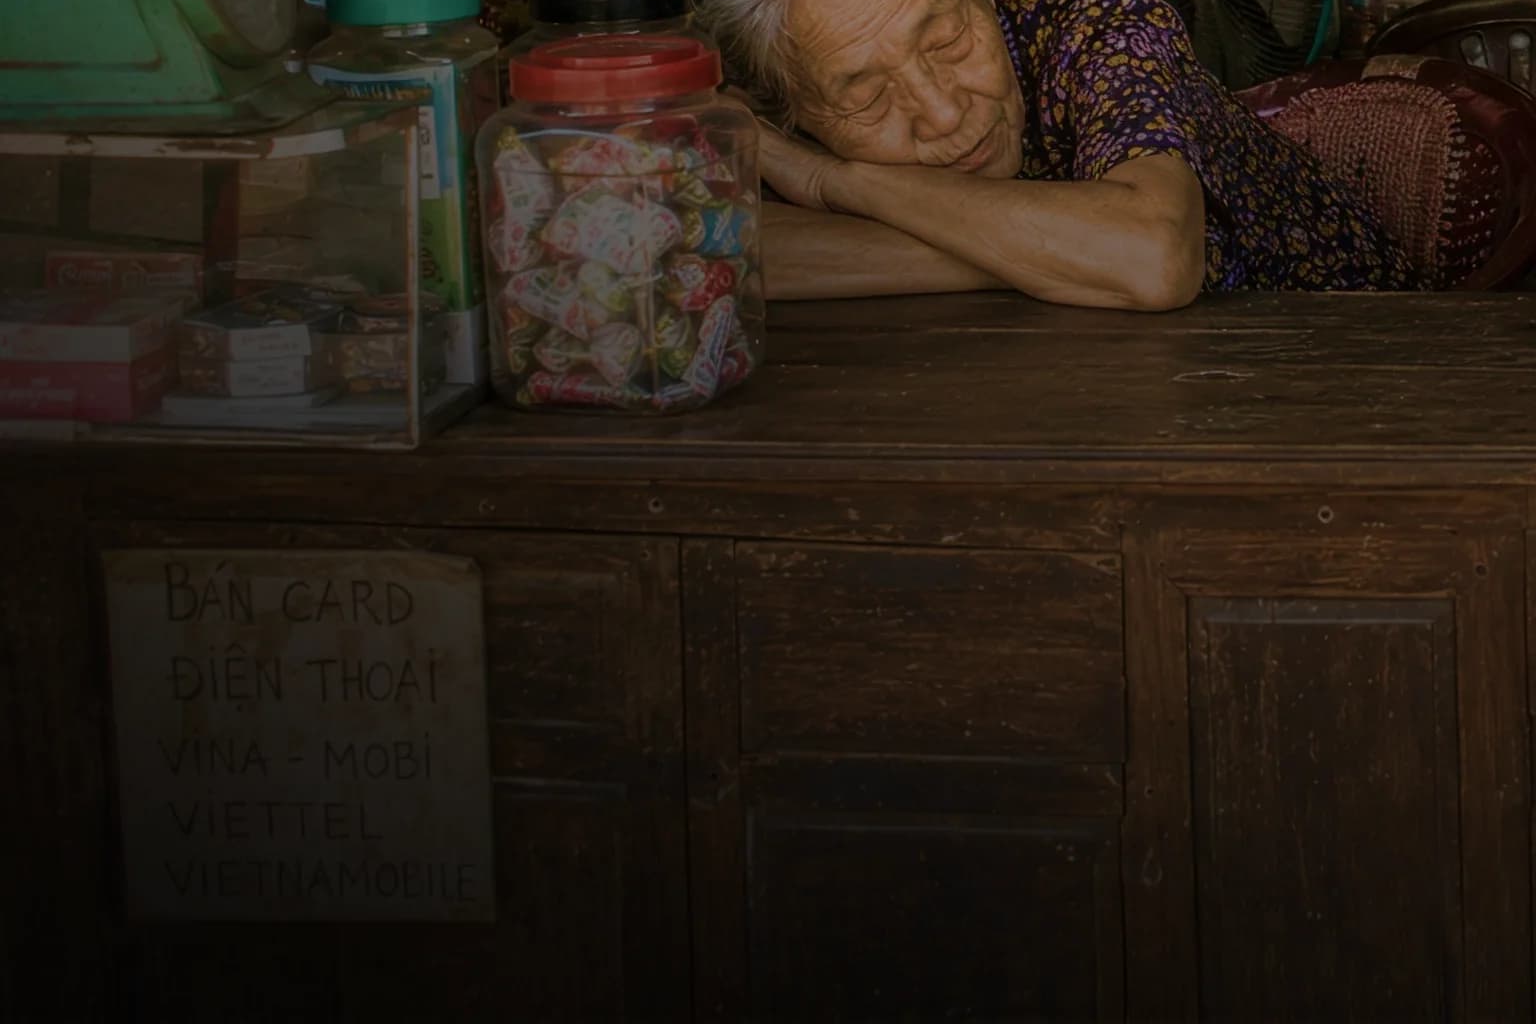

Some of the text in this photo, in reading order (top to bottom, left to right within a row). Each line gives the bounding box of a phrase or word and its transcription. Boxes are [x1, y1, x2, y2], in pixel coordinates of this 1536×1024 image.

[163, 560, 414, 625] BÁN CARD
[157, 736, 272, 777] VINA
[323, 731, 432, 781] MOBI
[167, 796, 384, 841] VIETTEL
